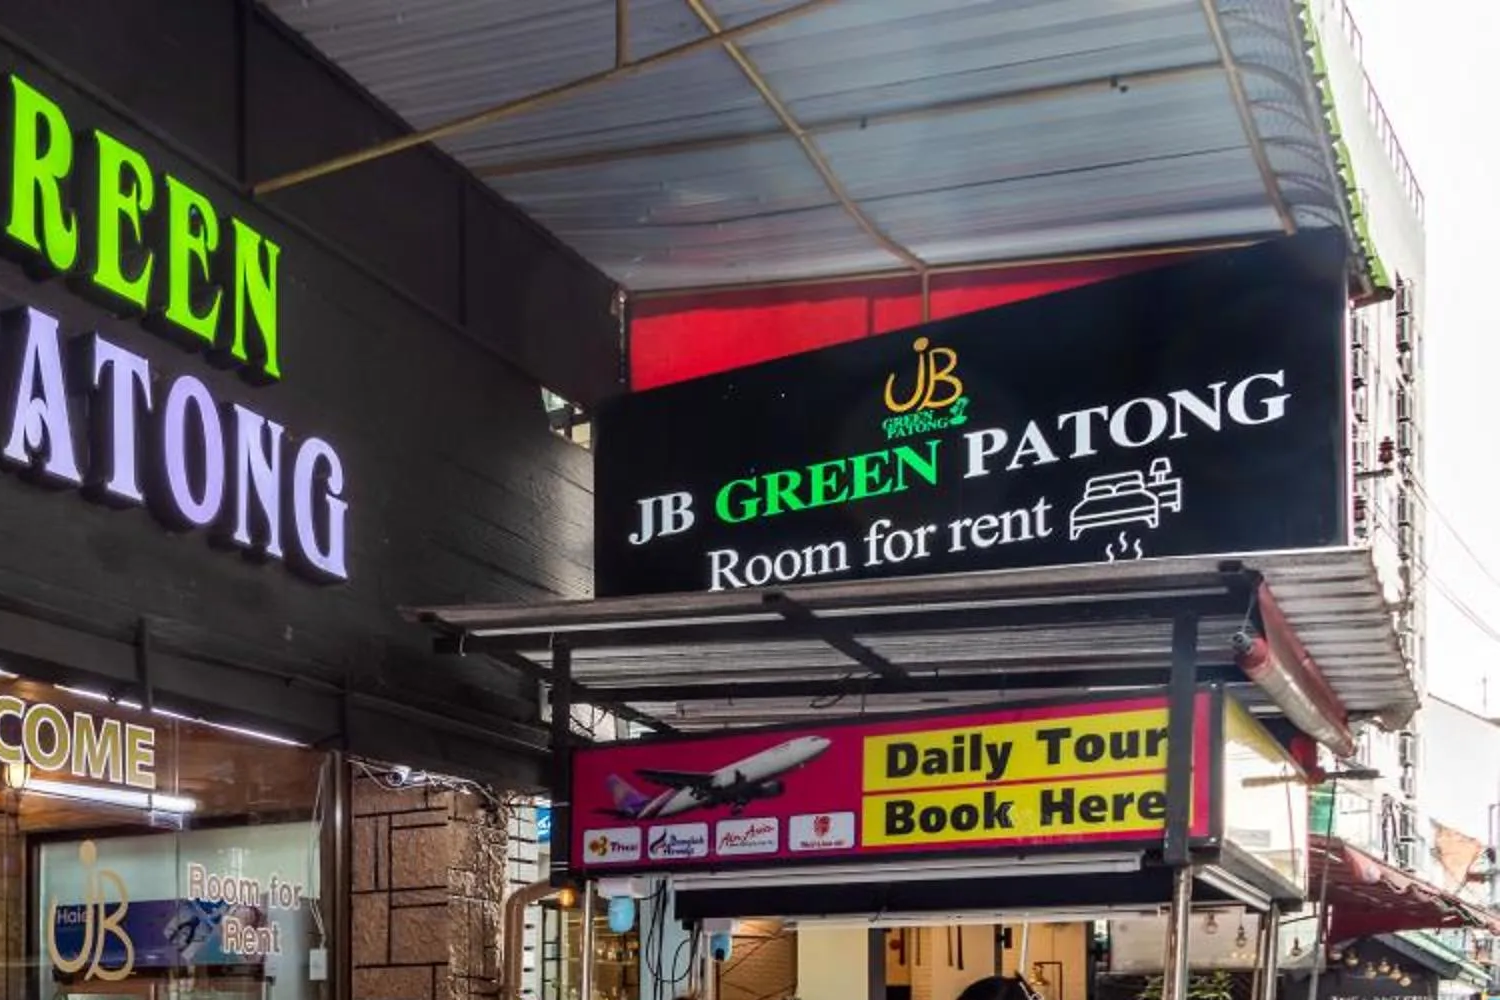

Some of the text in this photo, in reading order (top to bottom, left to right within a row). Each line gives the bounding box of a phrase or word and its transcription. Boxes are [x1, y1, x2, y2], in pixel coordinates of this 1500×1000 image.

[629, 370, 1293, 546] JB GREEN PATONG
[707, 496, 1053, 592] Room for rent
[885, 727, 1168, 781] Daily Tour
[884, 787, 1167, 837] Book Here
[186, 862, 303, 911] Room for
[221, 914, 283, 956] Rent
